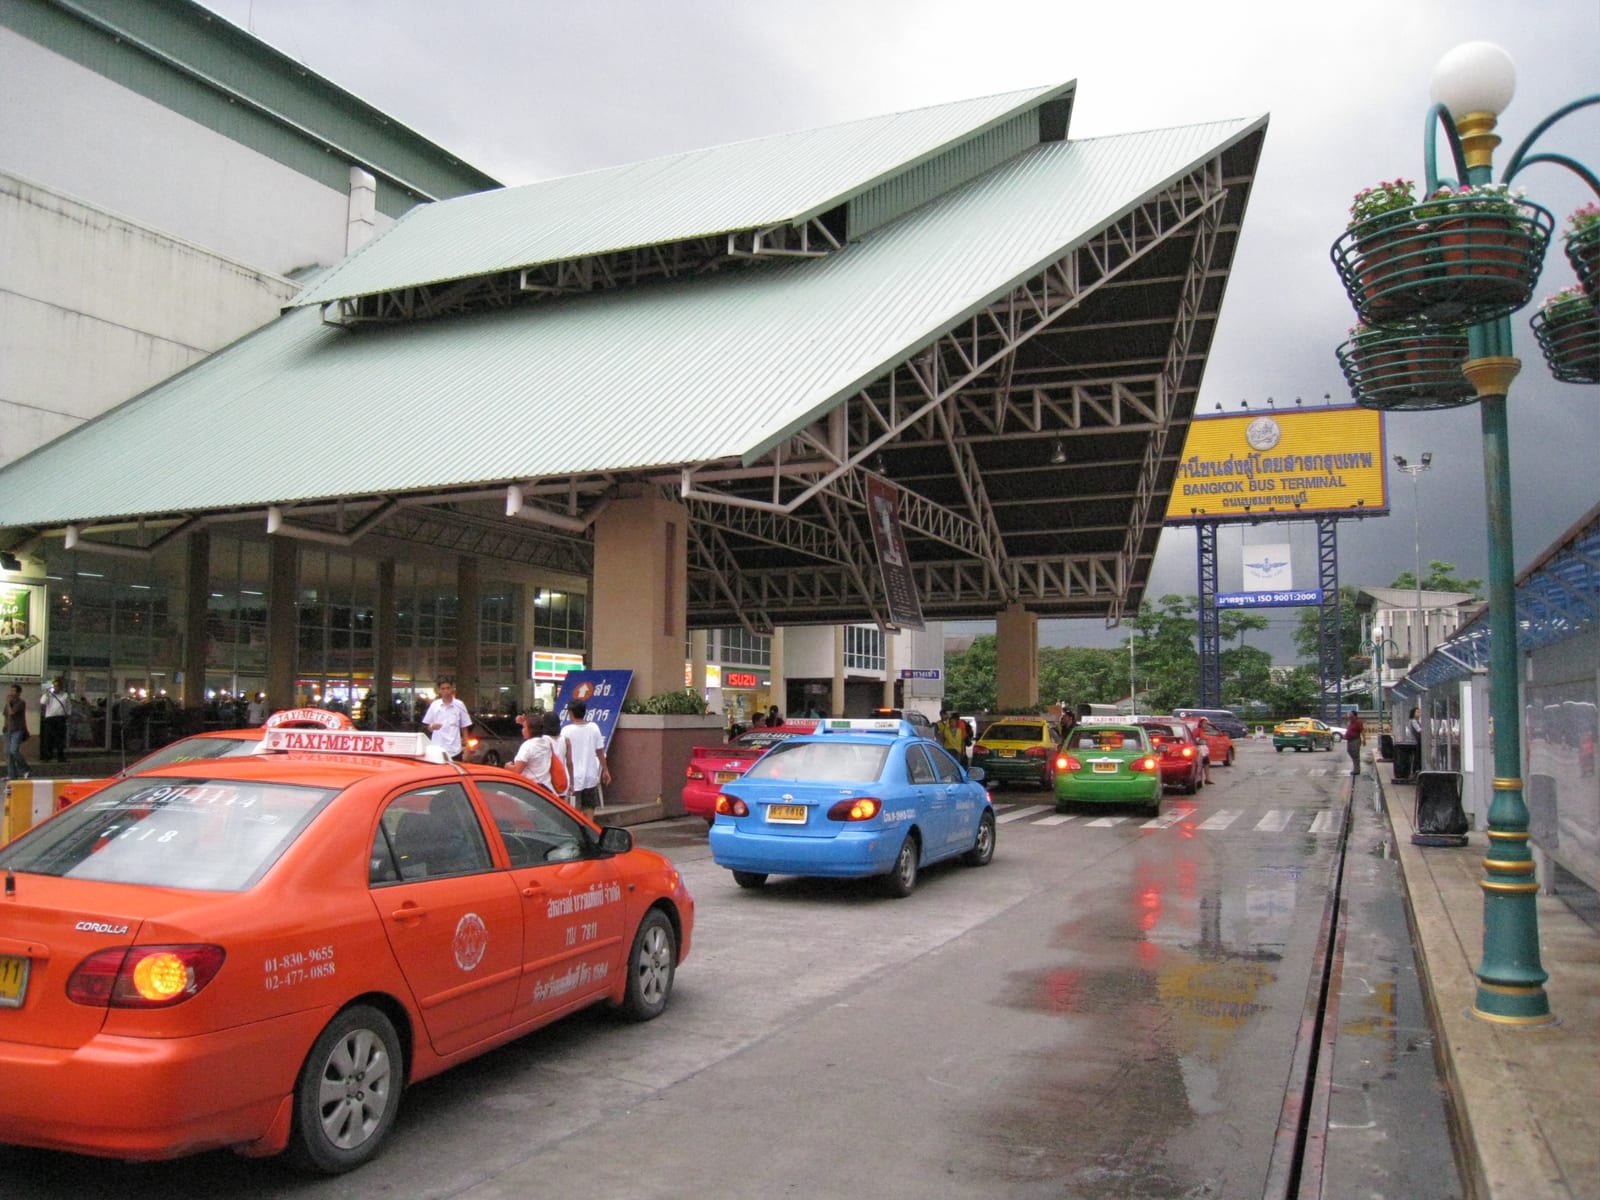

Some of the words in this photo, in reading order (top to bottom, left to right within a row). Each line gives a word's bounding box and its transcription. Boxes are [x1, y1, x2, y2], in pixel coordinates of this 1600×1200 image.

[1183, 481, 1244, 496] BANGKOK
[1249, 478, 1275, 491] BUS
[1280, 475, 1347, 490] TERMINAL
[1258, 594, 1272, 602] ISO
[1273, 593, 1317, 601] 9001:2000
[593, 679, 612, 697] ส่ง
[728, 672, 757, 687] ISUZU
[285, 732, 385, 752] TAXI-METER
[75, 921, 129, 934] COROLLA
[265, 945, 335, 973] 01-830-9655
[265, 961, 336, 991] 02-477-0858
